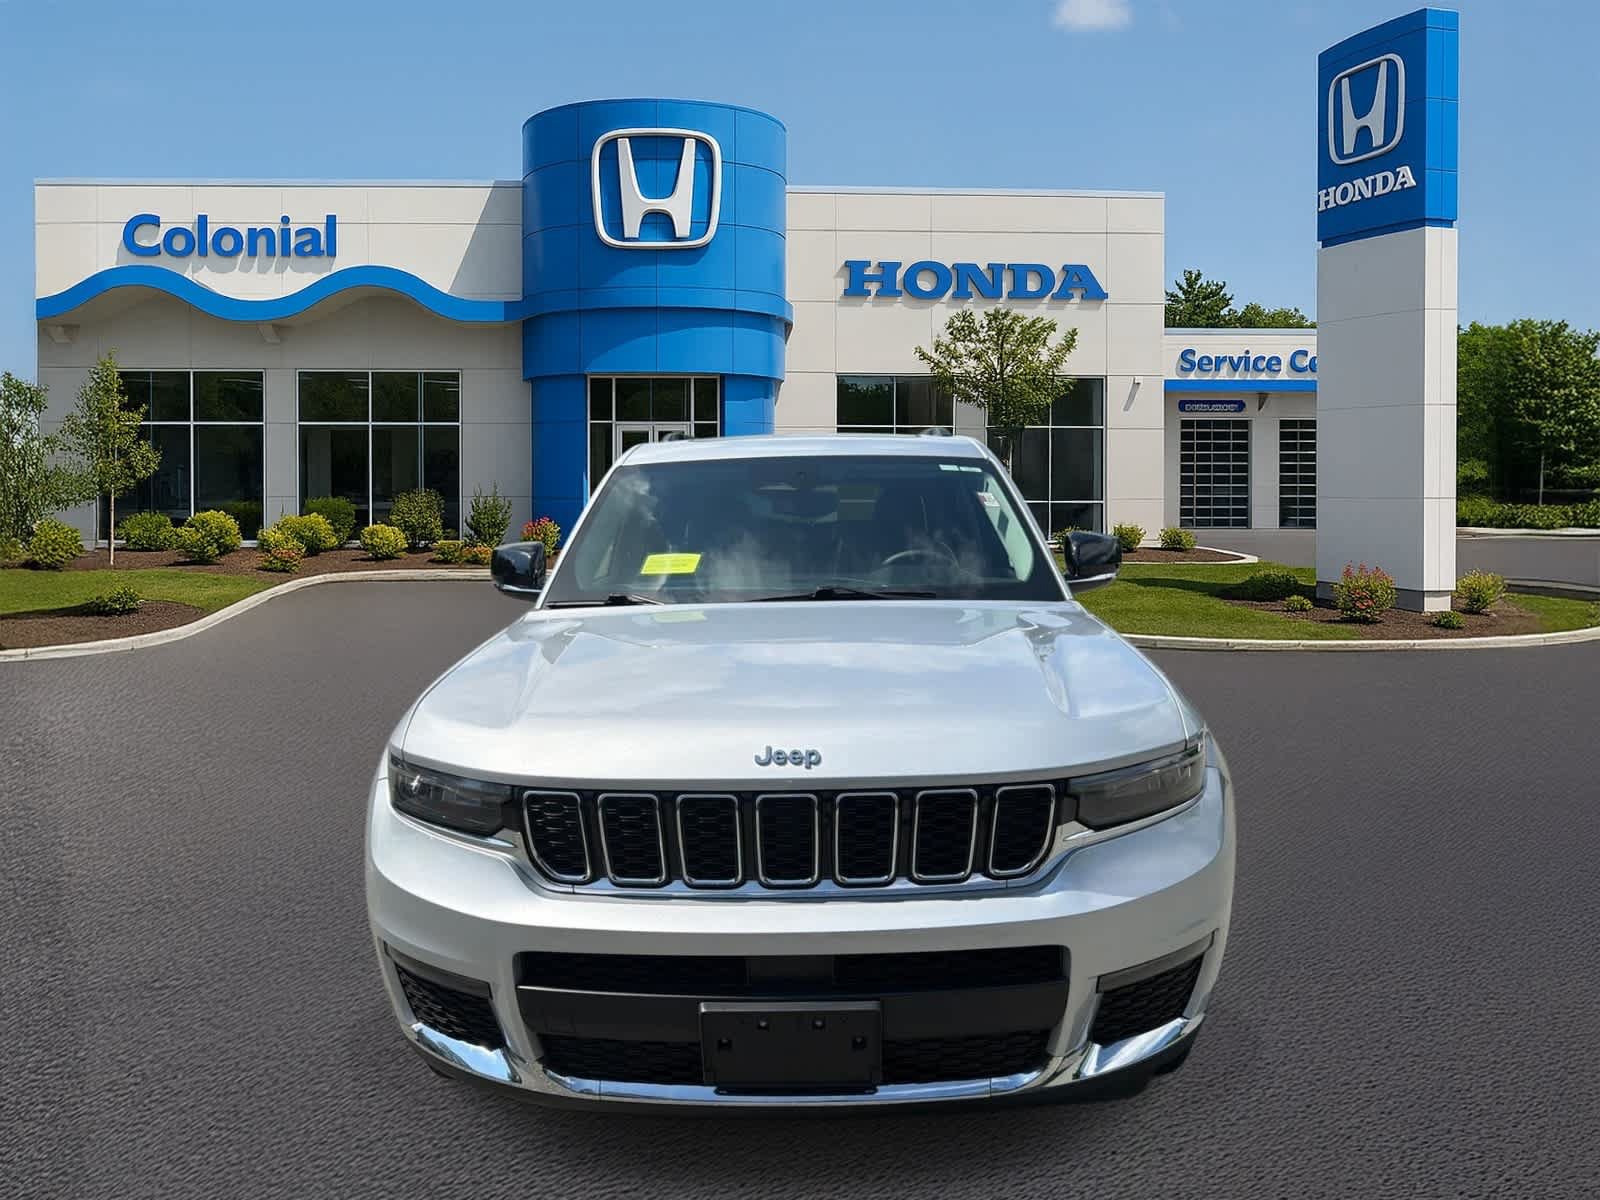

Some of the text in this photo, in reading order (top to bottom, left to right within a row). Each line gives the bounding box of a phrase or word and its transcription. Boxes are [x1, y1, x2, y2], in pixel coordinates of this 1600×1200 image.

[1318, 165, 1416, 212] HONDA
[122, 213, 337, 257] Colonial
[843, 260, 1108, 299] HONDA
[1180, 349, 1282, 373] Service
[754, 745, 822, 770] Jeep
